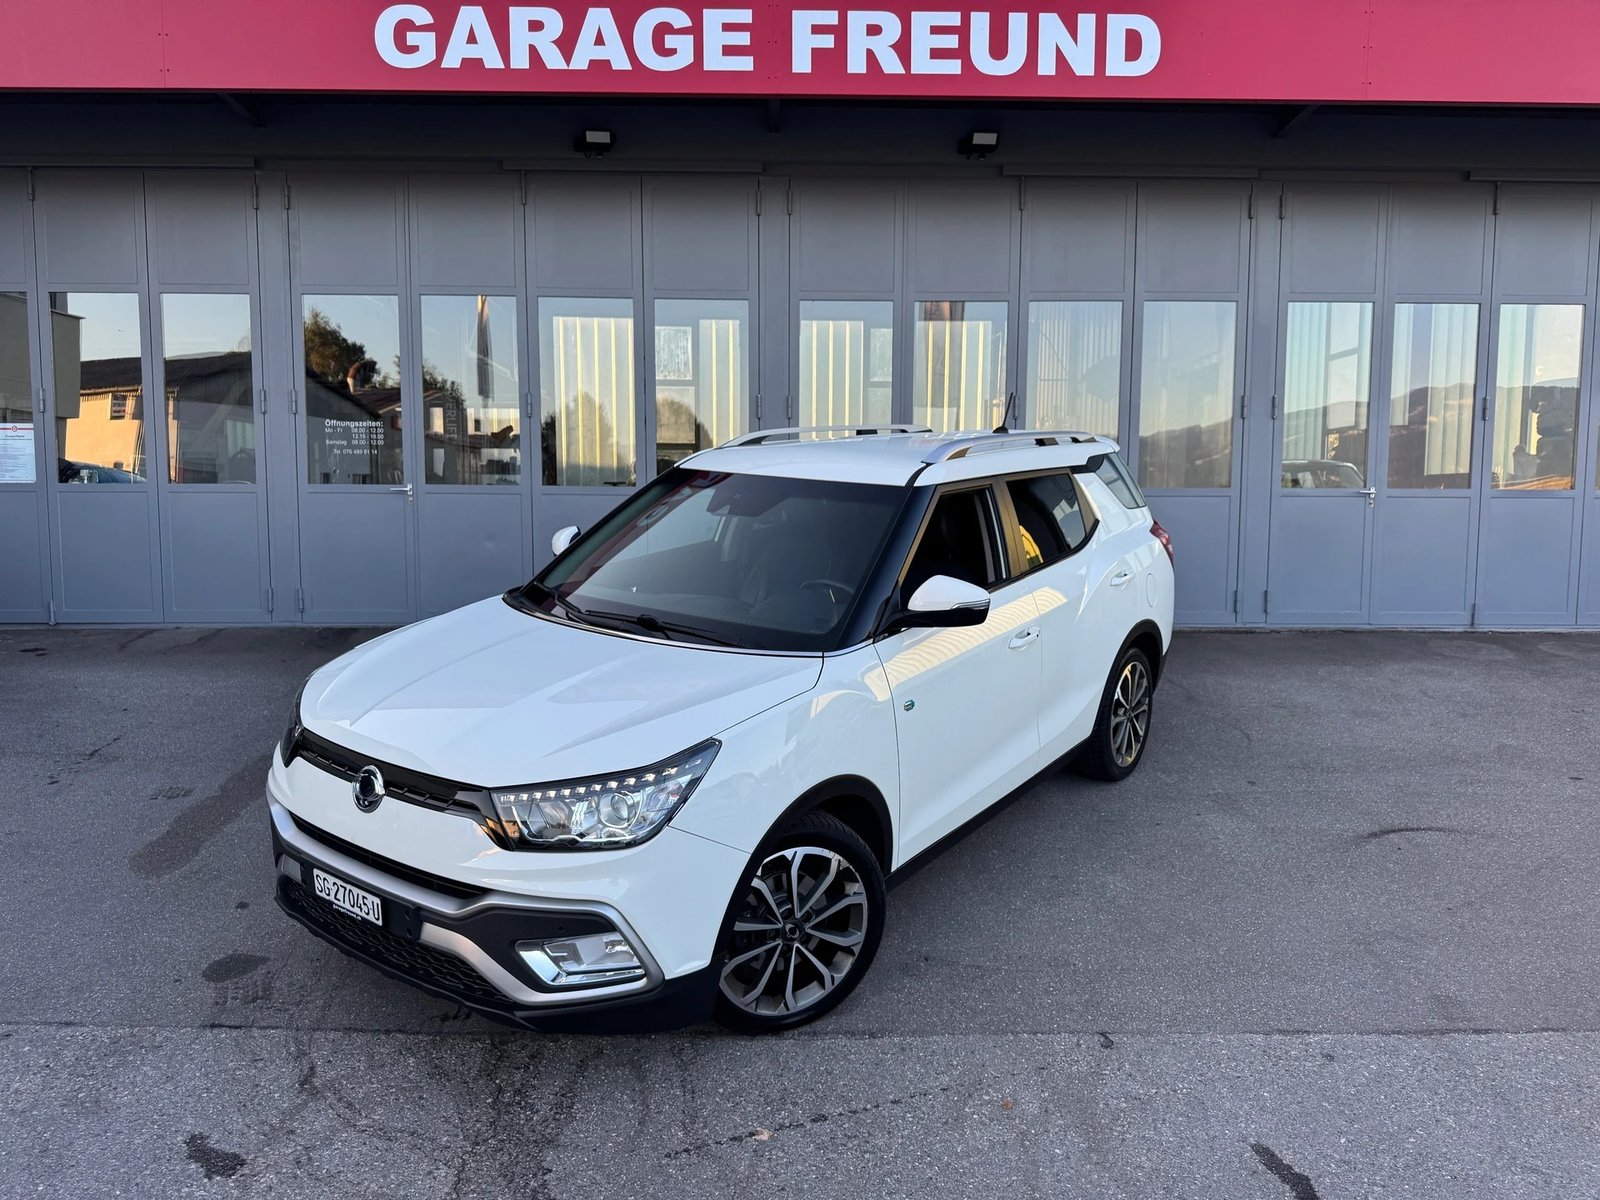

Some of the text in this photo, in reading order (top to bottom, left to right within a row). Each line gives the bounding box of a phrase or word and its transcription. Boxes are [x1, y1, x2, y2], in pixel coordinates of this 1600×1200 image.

[374, 4, 1162, 77] GARAGE FREUND
[324, 418, 384, 428] Öffnungszeiten:
